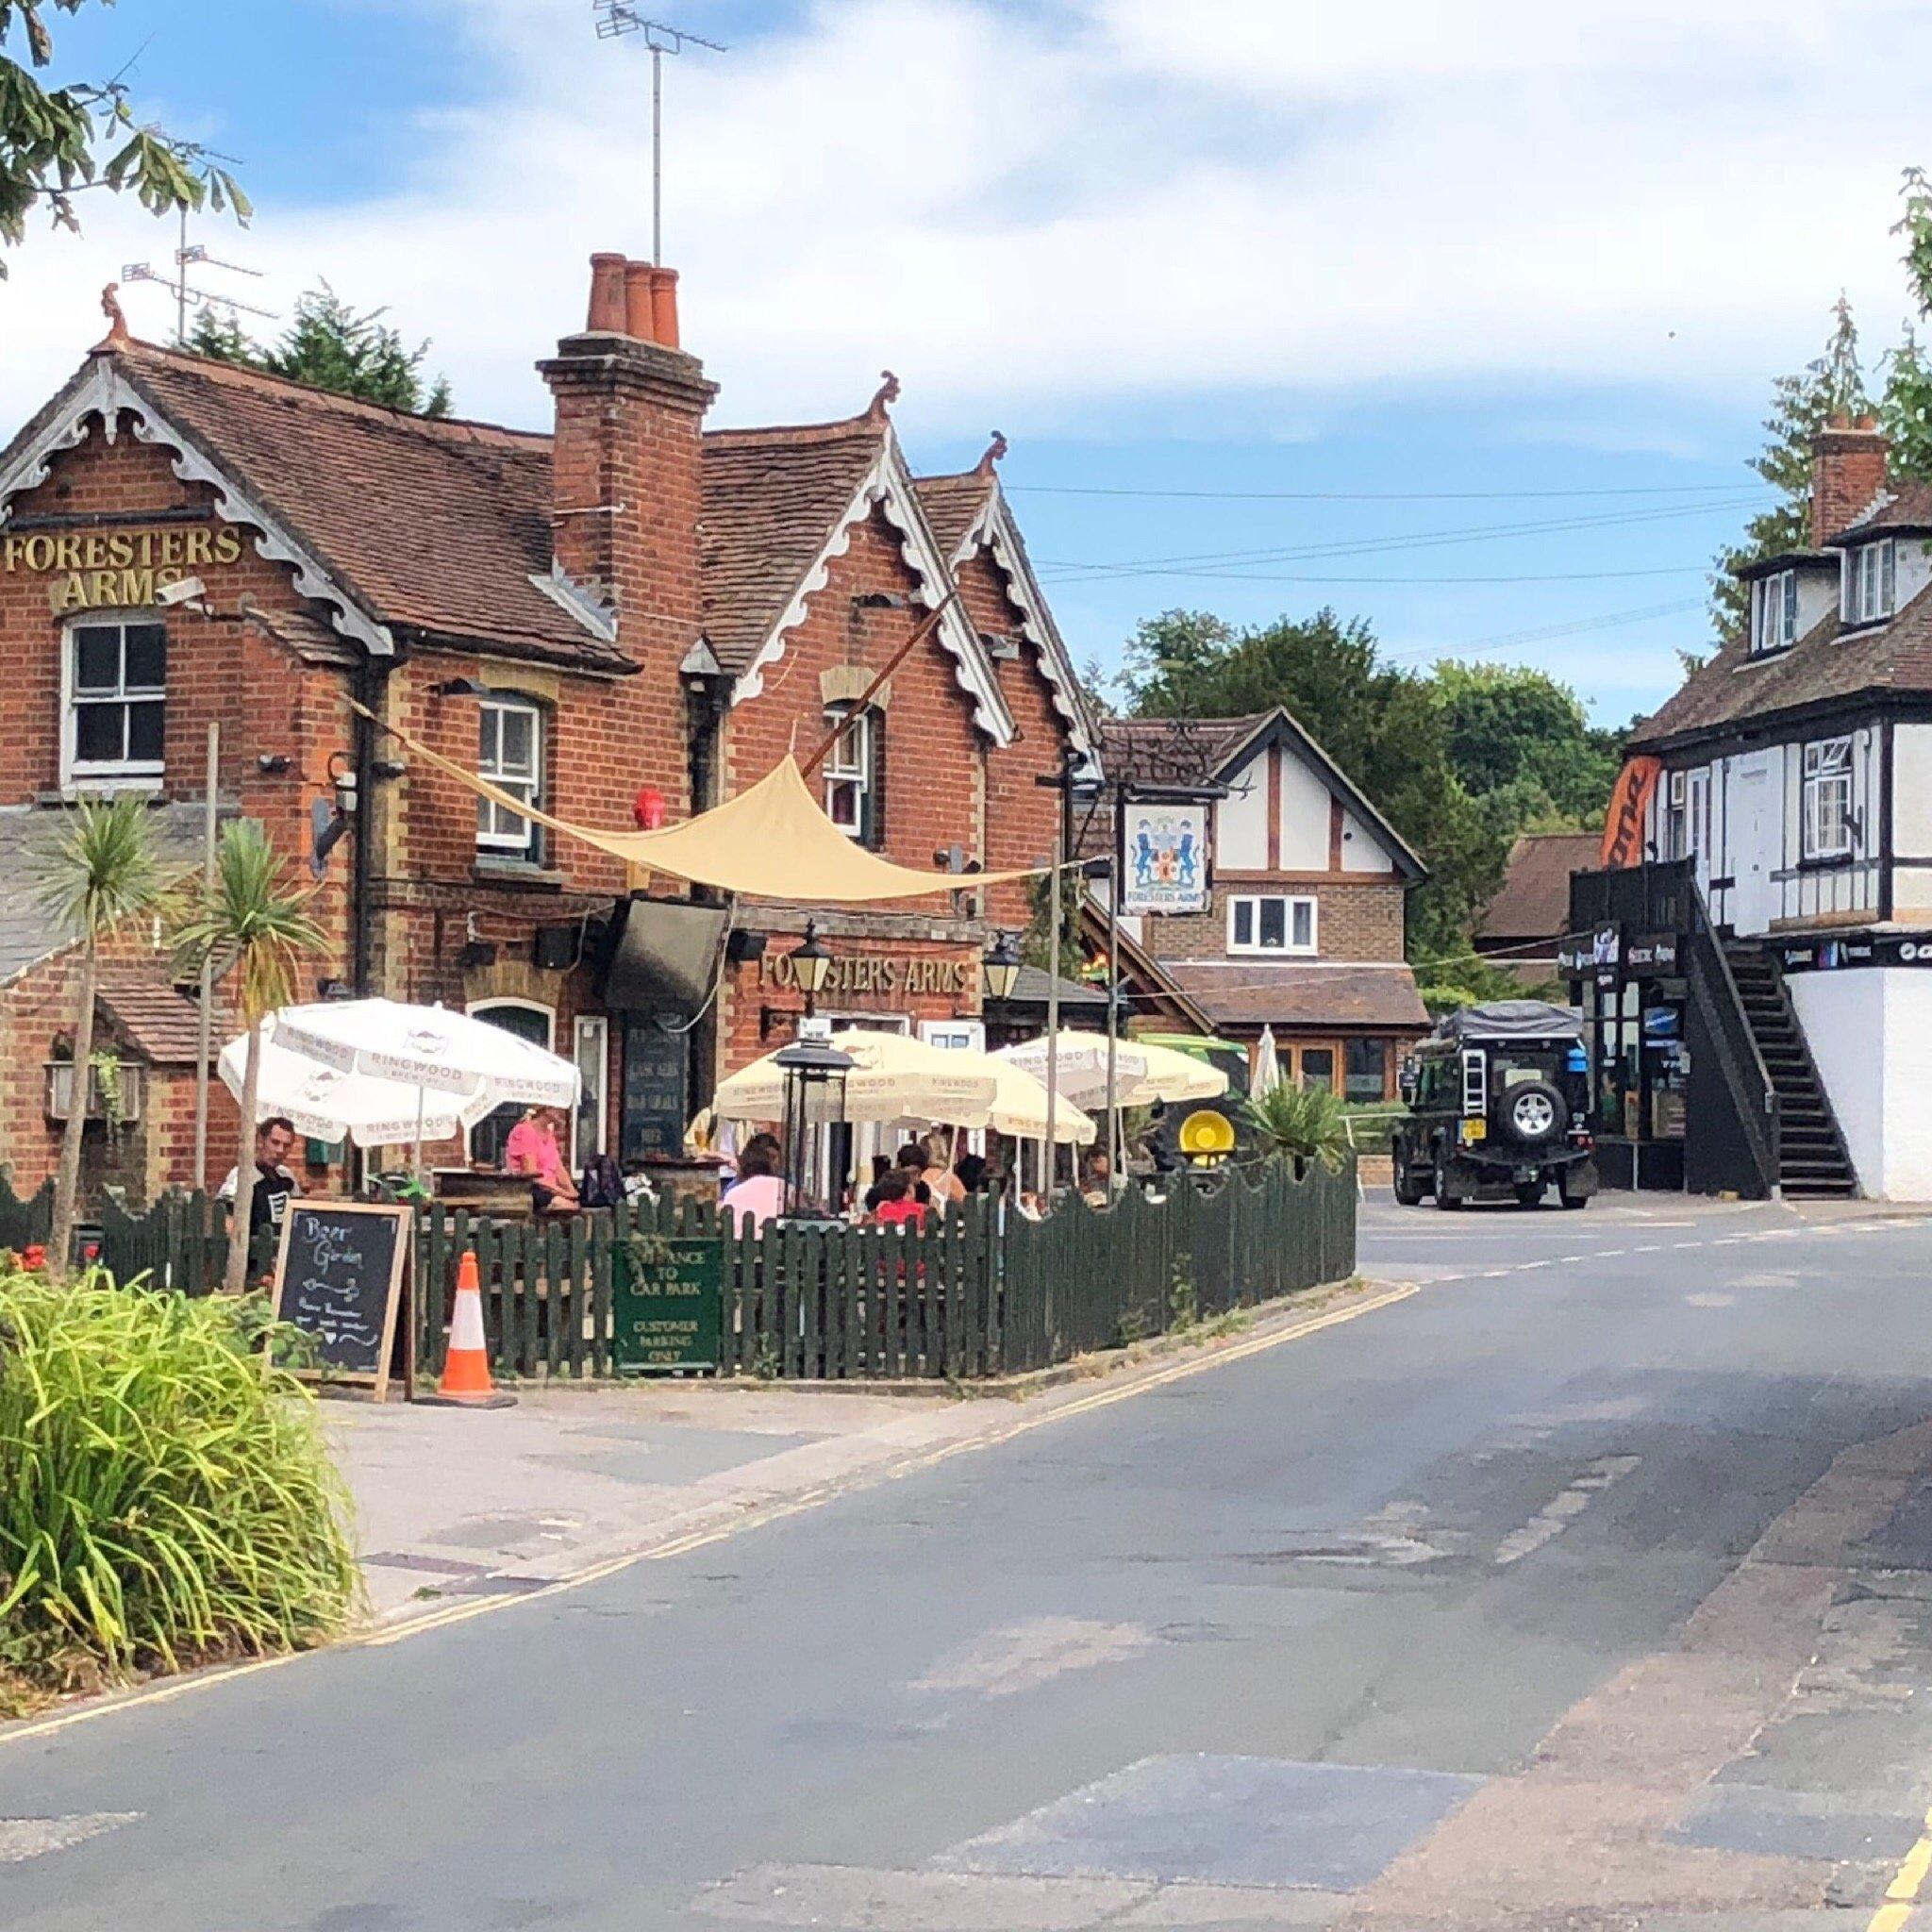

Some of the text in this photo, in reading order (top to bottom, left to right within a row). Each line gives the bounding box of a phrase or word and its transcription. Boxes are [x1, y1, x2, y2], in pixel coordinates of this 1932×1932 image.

[4, 526, 242, 572] FORESTERS
[759, 952, 969, 992] FOSTERS ARMS
[372, 1052, 462, 1080] RINGWOOD
[658, 1267, 678, 1280] TO
[666, 1281, 701, 1295] PARK
